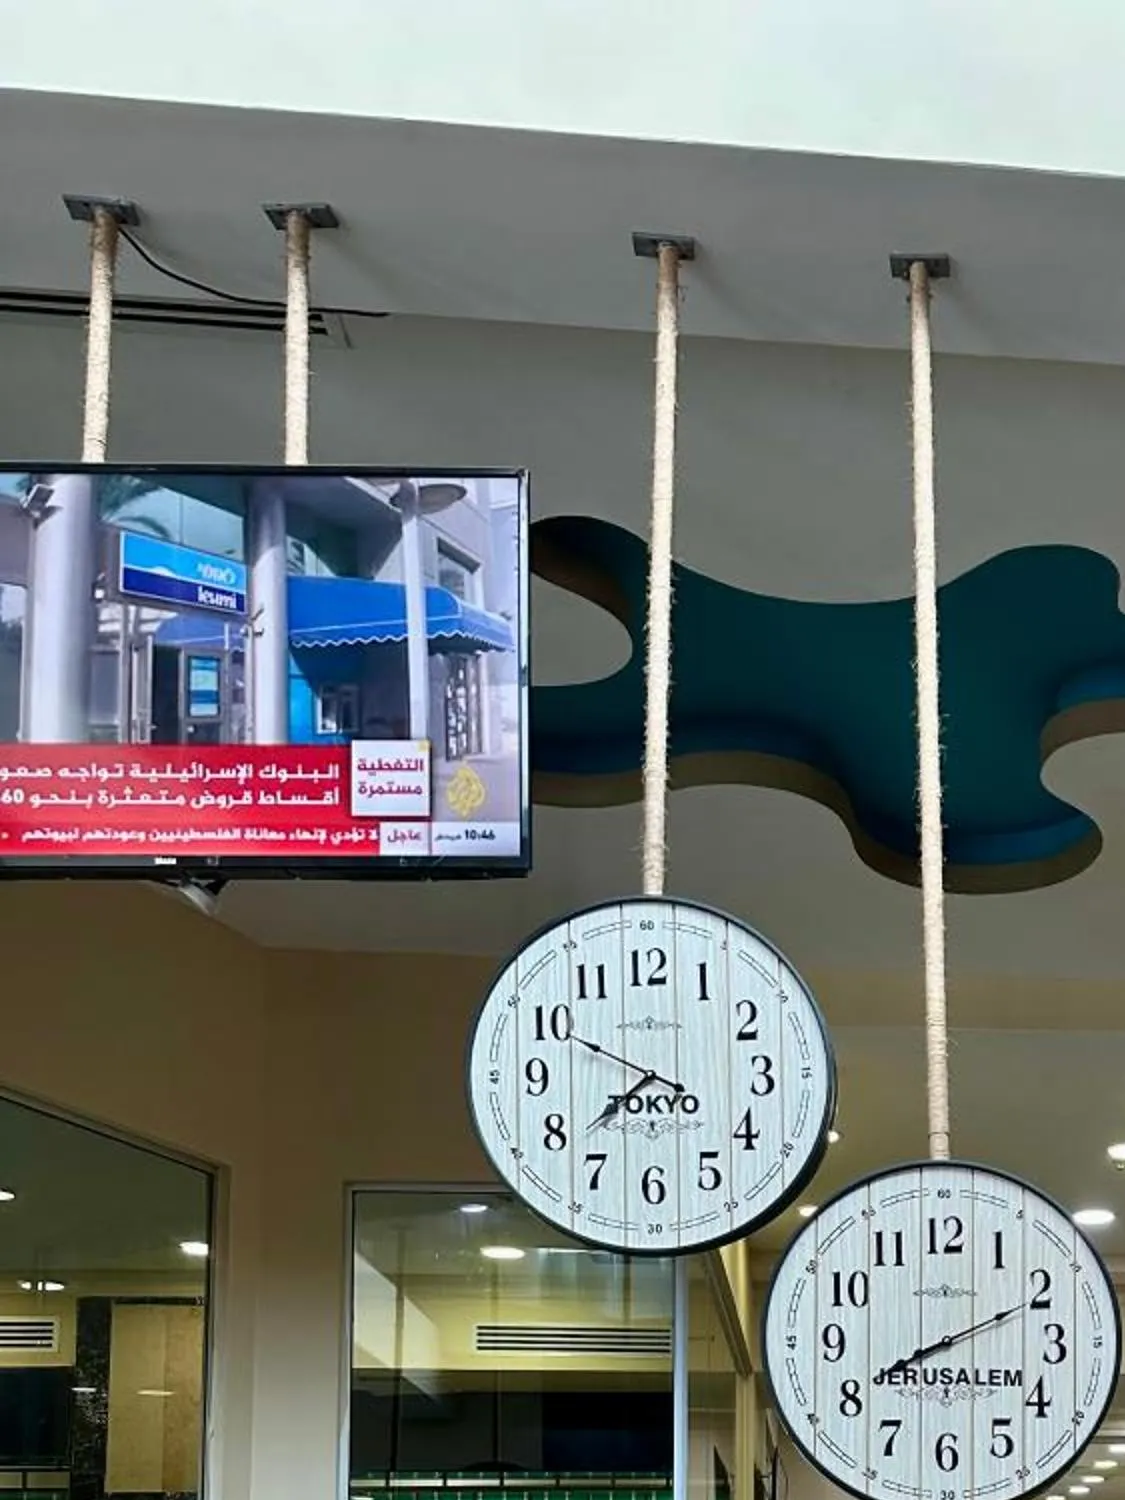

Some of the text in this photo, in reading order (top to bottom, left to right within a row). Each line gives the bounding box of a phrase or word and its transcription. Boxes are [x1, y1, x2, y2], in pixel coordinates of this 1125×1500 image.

[58, 764, 125, 782] تواجه
[129, 762, 254, 785] الإسرائيلية
[258, 763, 340, 783] البنوك
[357, 758, 424, 777] التغطية
[29, 789, 93, 809] بنحو
[98, 786, 187, 809] متعثرة
[190, 790, 253, 809] قروض
[257, 786, 340, 805] أقساط
[358, 781, 423, 798] مستمرة
[330, 827, 367, 845] تؤدي
[387, 829, 422, 843] عاجل
[464, 829, 496, 841] 10:46
[639, 920, 655, 931] 60
[576, 964, 608, 1000] 11
[629, 947, 668, 987] 12
[696, 962, 711, 1001] 1
[535, 1004, 574, 1042] 10
[735, 1000, 759, 1041] 2
[489, 1069, 500, 1084] 45
[525, 1057, 549, 1097] 9
[751, 1055, 775, 1096] 3
[801, 1067, 812, 1079] 15
[608, 1095, 699, 1114] TOKYO
[544, 1114, 567, 1151] 8
[733, 1107, 761, 1151] 4
[584, 1154, 608, 1191] 7
[641, 1166, 666, 1205] 6
[698, 1151, 722, 1190] 5
[568, 1201, 583, 1215] 35
[937, 1189, 952, 1199] 60
[647, 1223, 663, 1235] 30
[927, 1216, 964, 1255] 12
[873, 1231, 905, 1267] 11
[993, 1231, 1005, 1269] 1
[805, 1260, 818, 1275] 50
[832, 1270, 869, 1308] 10
[1030, 1269, 1052, 1310] 2
[786, 1335, 797, 1350] 45
[822, 1323, 846, 1362] 9
[1043, 1324, 1067, 1364] 3
[873, 1367, 1023, 1387] JERUSALEM
[839, 1379, 863, 1417] 8
[1025, 1376, 1052, 1418] 4
[879, 1419, 902, 1457] 7
[935, 1432, 959, 1472] 6
[989, 1418, 1014, 1459] 5
[940, 1491, 955, 1500] 30
